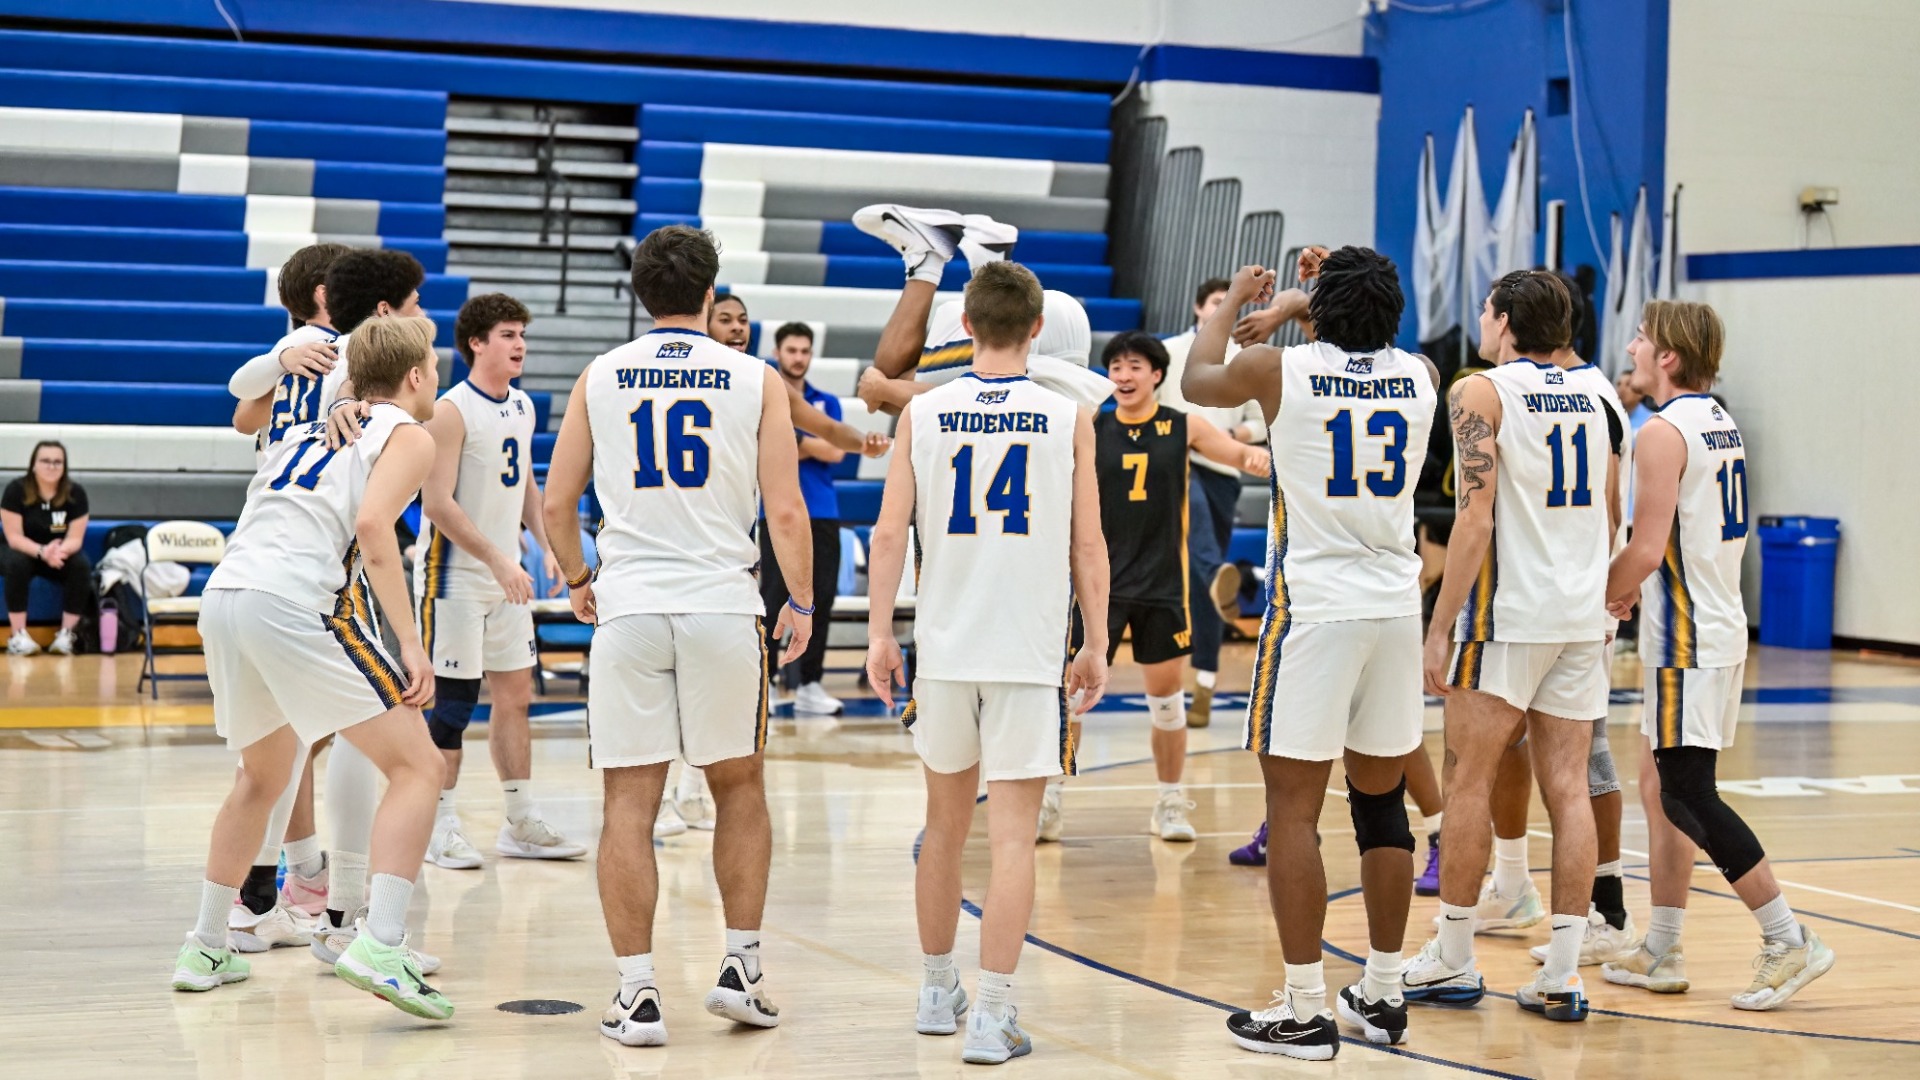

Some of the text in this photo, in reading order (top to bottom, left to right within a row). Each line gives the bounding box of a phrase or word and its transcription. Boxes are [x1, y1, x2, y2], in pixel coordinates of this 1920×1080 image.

[658, 349, 690, 359] MAC
[616, 368, 731, 390] WIDENER
[1309, 374, 1417, 399] WIDENER
[1546, 373, 1563, 384] MAC
[1522, 392, 1596, 413] WIDENER
[938, 411, 1048, 433] WIDENER
[1154, 419, 1172, 436] W
[628, 398, 713, 490] 16
[1701, 429, 1742, 450] WIDENE
[501, 436, 520, 487] 3
[1324, 407, 1409, 499] 13
[1122, 452, 1148, 501] 7
[1545, 422, 1592, 509] 11
[947, 442, 1032, 536] 14
[1716, 457, 1748, 542] 10
[51, 511, 67, 526] W
[157, 533, 217, 547] Widener
